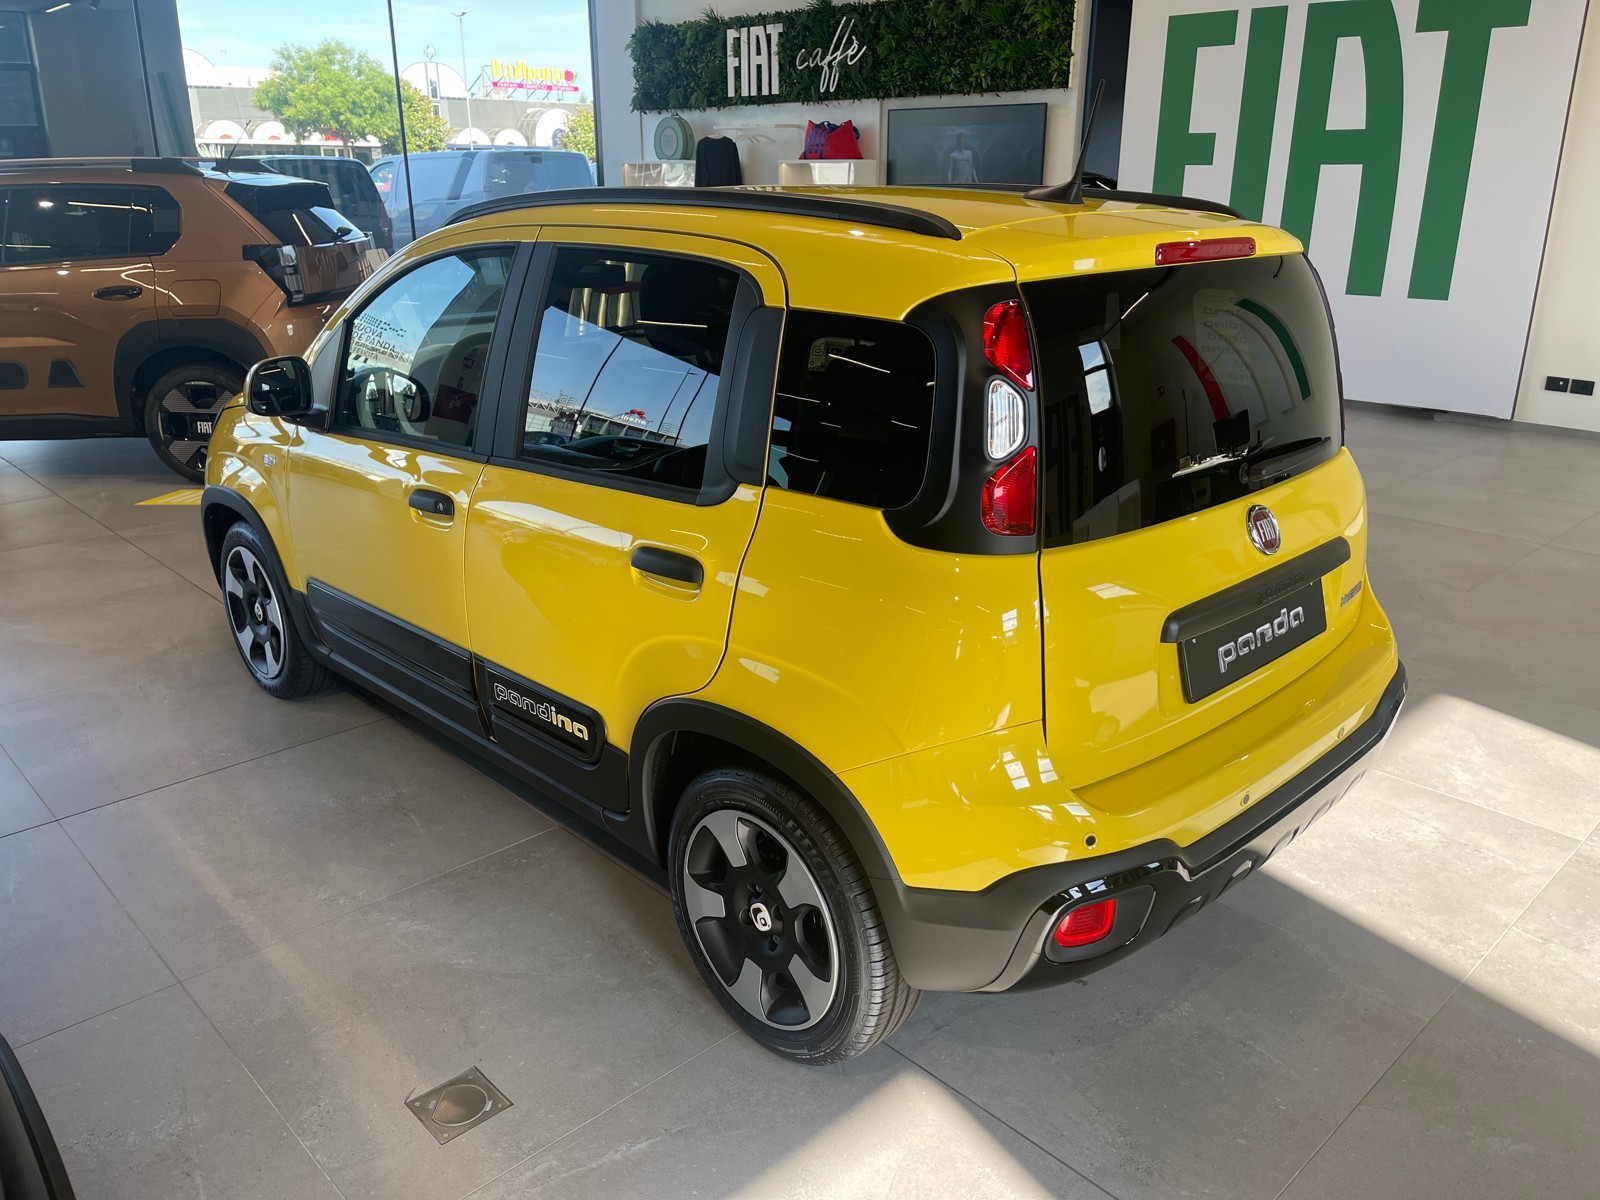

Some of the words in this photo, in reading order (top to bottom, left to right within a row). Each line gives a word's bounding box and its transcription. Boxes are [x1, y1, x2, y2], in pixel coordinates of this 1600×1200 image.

[726, 23, 783, 97] FIAT
[796, 16, 867, 93] caffè
[1152, 0, 1531, 301] FIAT
[365, 335, 396, 352] PANDA
[196, 421, 213, 434] FIAT
[1256, 517, 1276, 543] FIAT
[1218, 606, 1305, 673] panda
[494, 683, 589, 741] pandina
